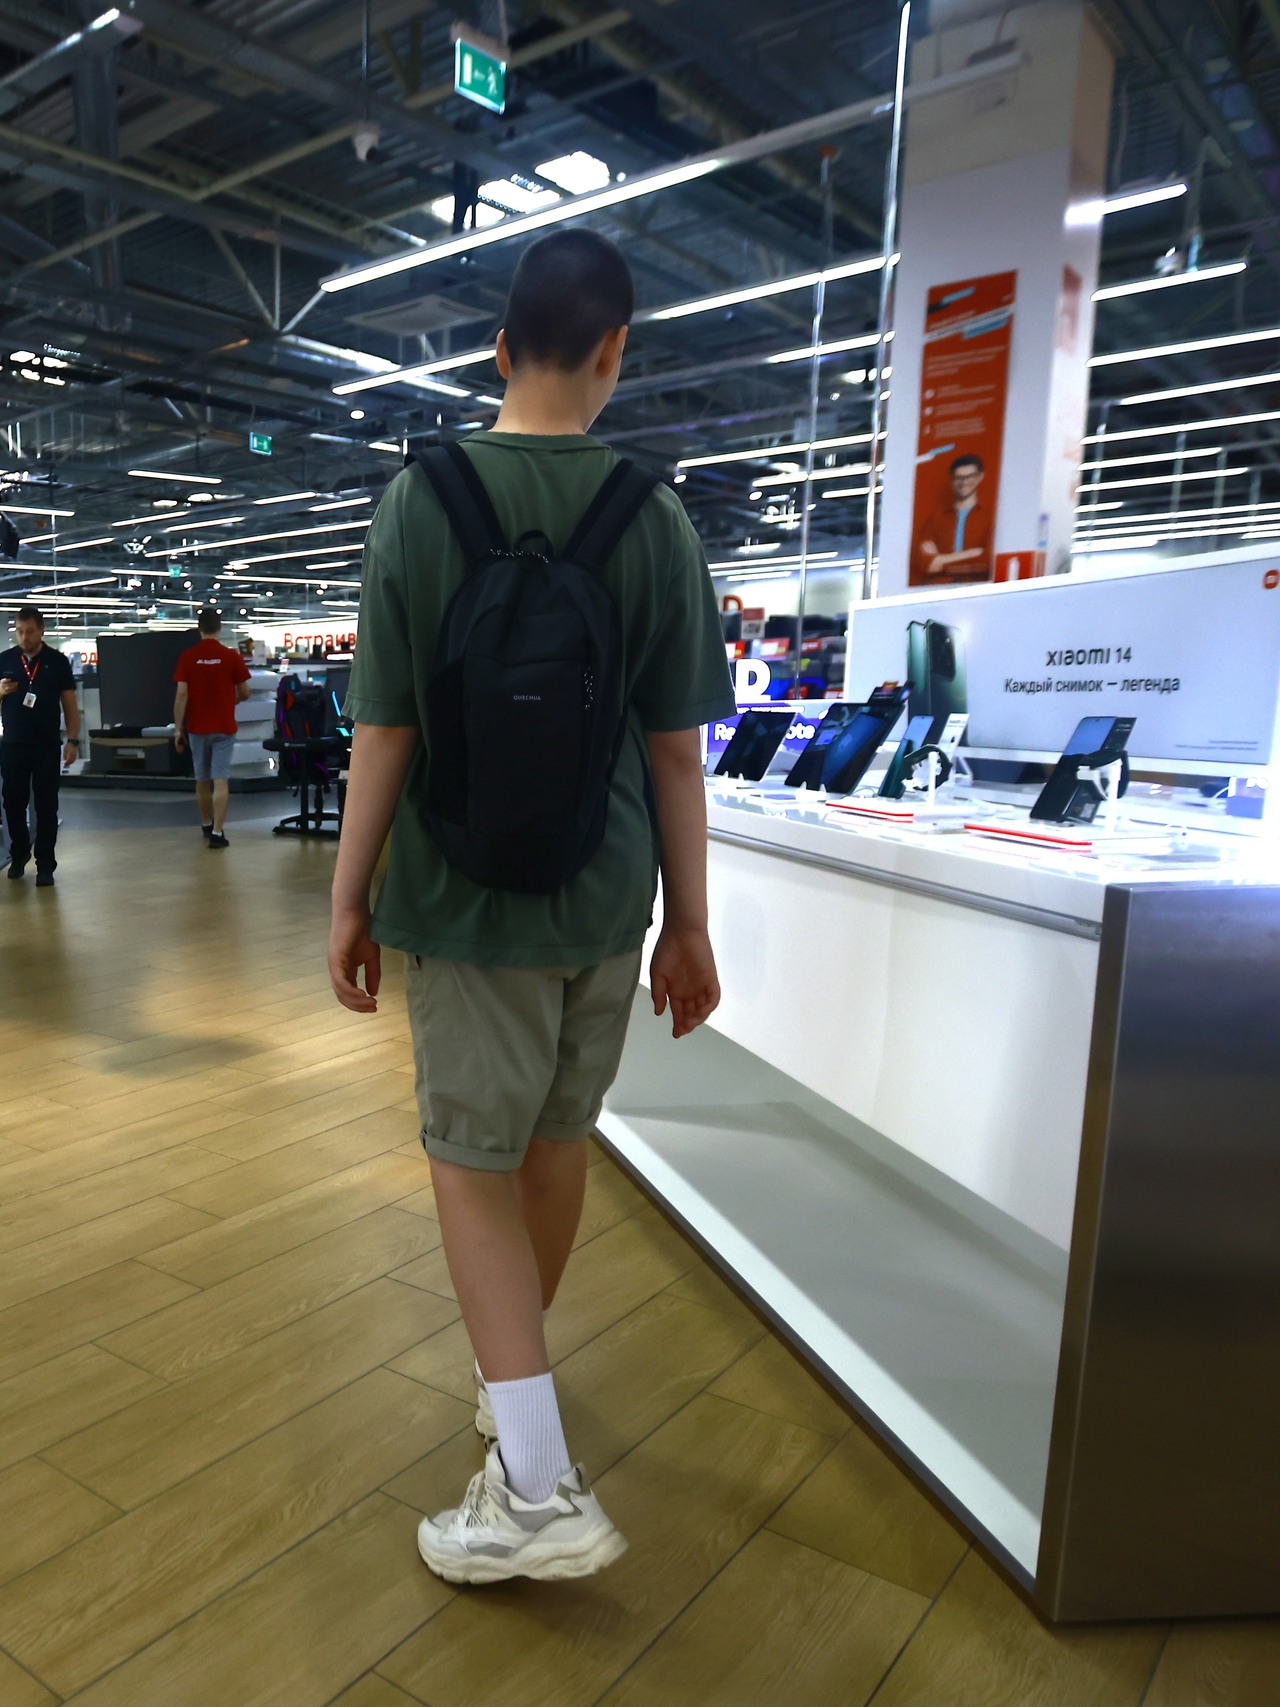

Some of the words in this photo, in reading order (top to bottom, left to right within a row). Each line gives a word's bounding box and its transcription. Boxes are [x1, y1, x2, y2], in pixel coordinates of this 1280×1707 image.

[284, 633, 357, 649] Встраив
[1116, 646, 1133, 664] 14
[1004, 677, 1053, 695] Каждый
[1056, 678, 1104, 693] снимок
[1120, 677, 1181, 695] легенда
[785, 723, 816, 740] ote
